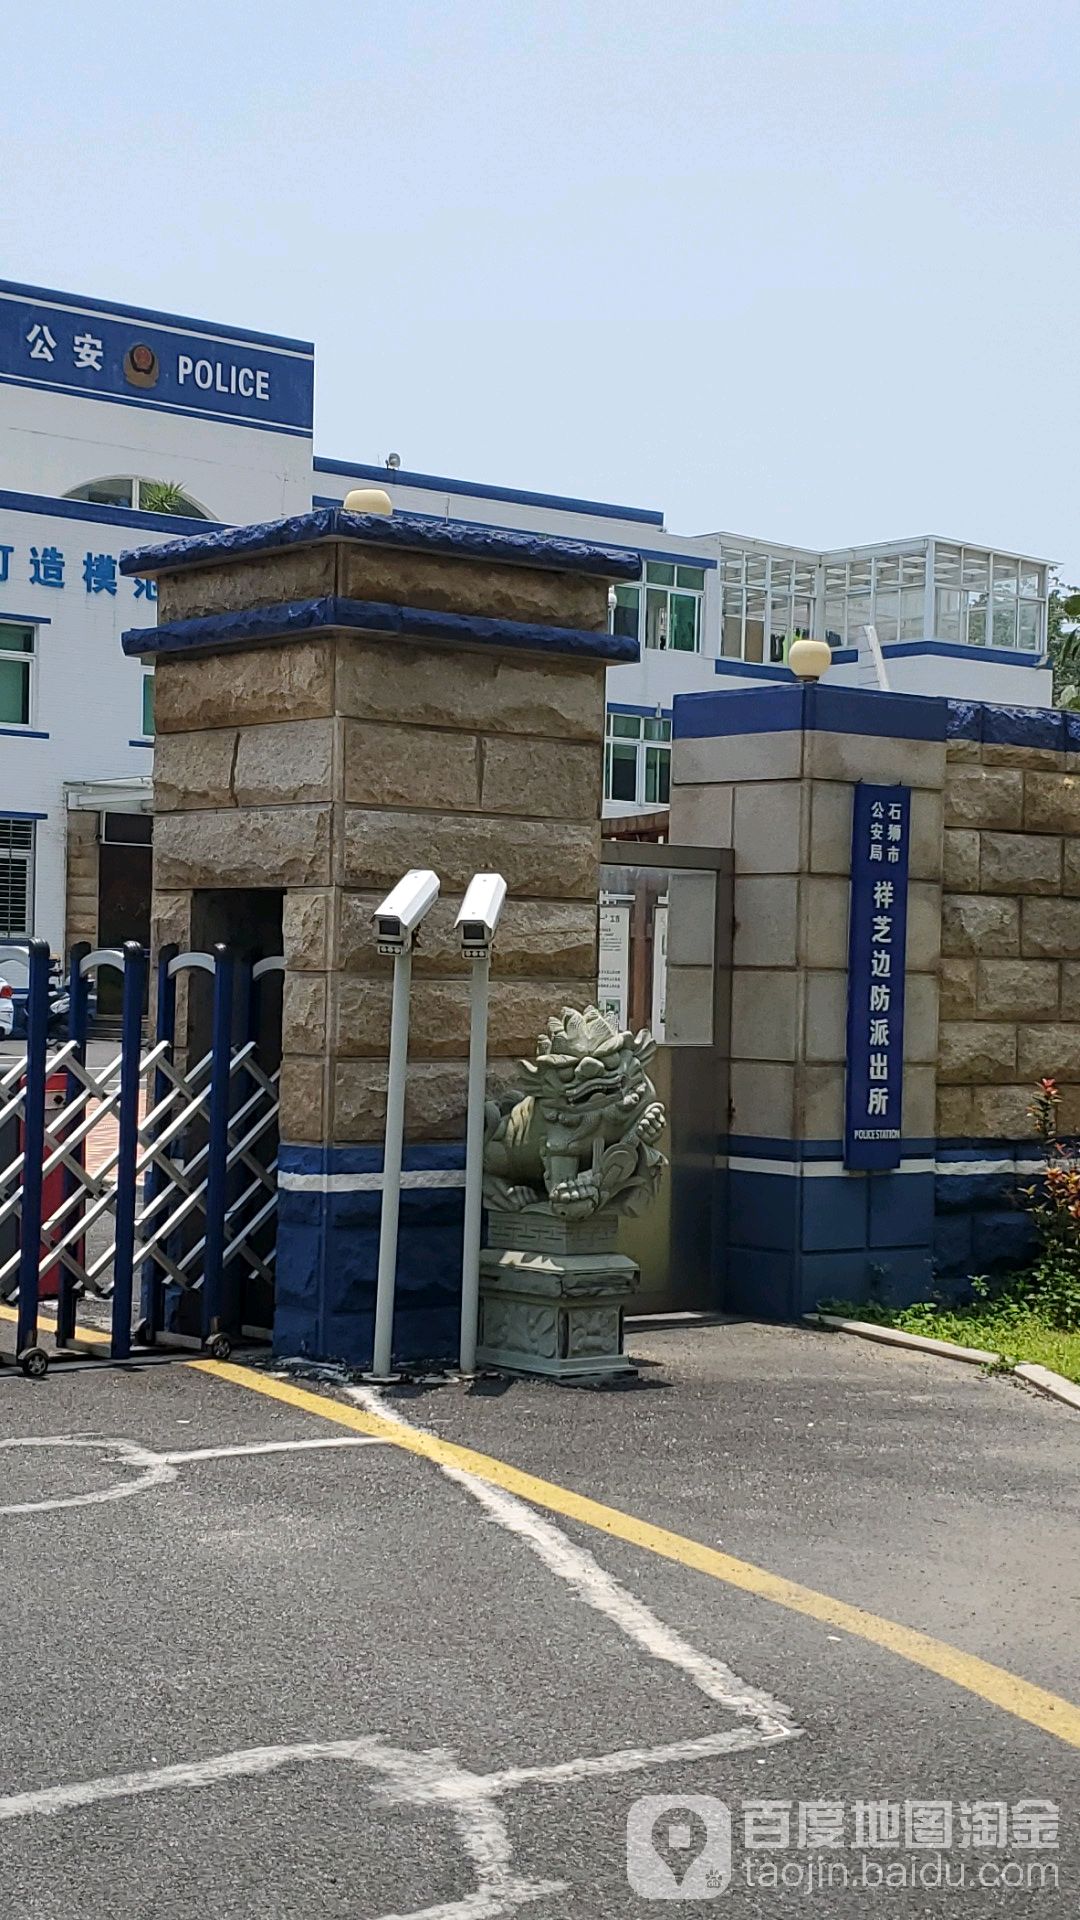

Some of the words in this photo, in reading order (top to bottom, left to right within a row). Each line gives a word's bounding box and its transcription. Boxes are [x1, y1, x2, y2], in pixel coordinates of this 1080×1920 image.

[26, 323, 104, 371] 公安
[178, 355, 270, 400] POLICE
[869, 801, 885, 861] 公安局
[887, 803, 902, 863] 石狮市
[868, 881, 893, 1115] 祥芝边防派出所
